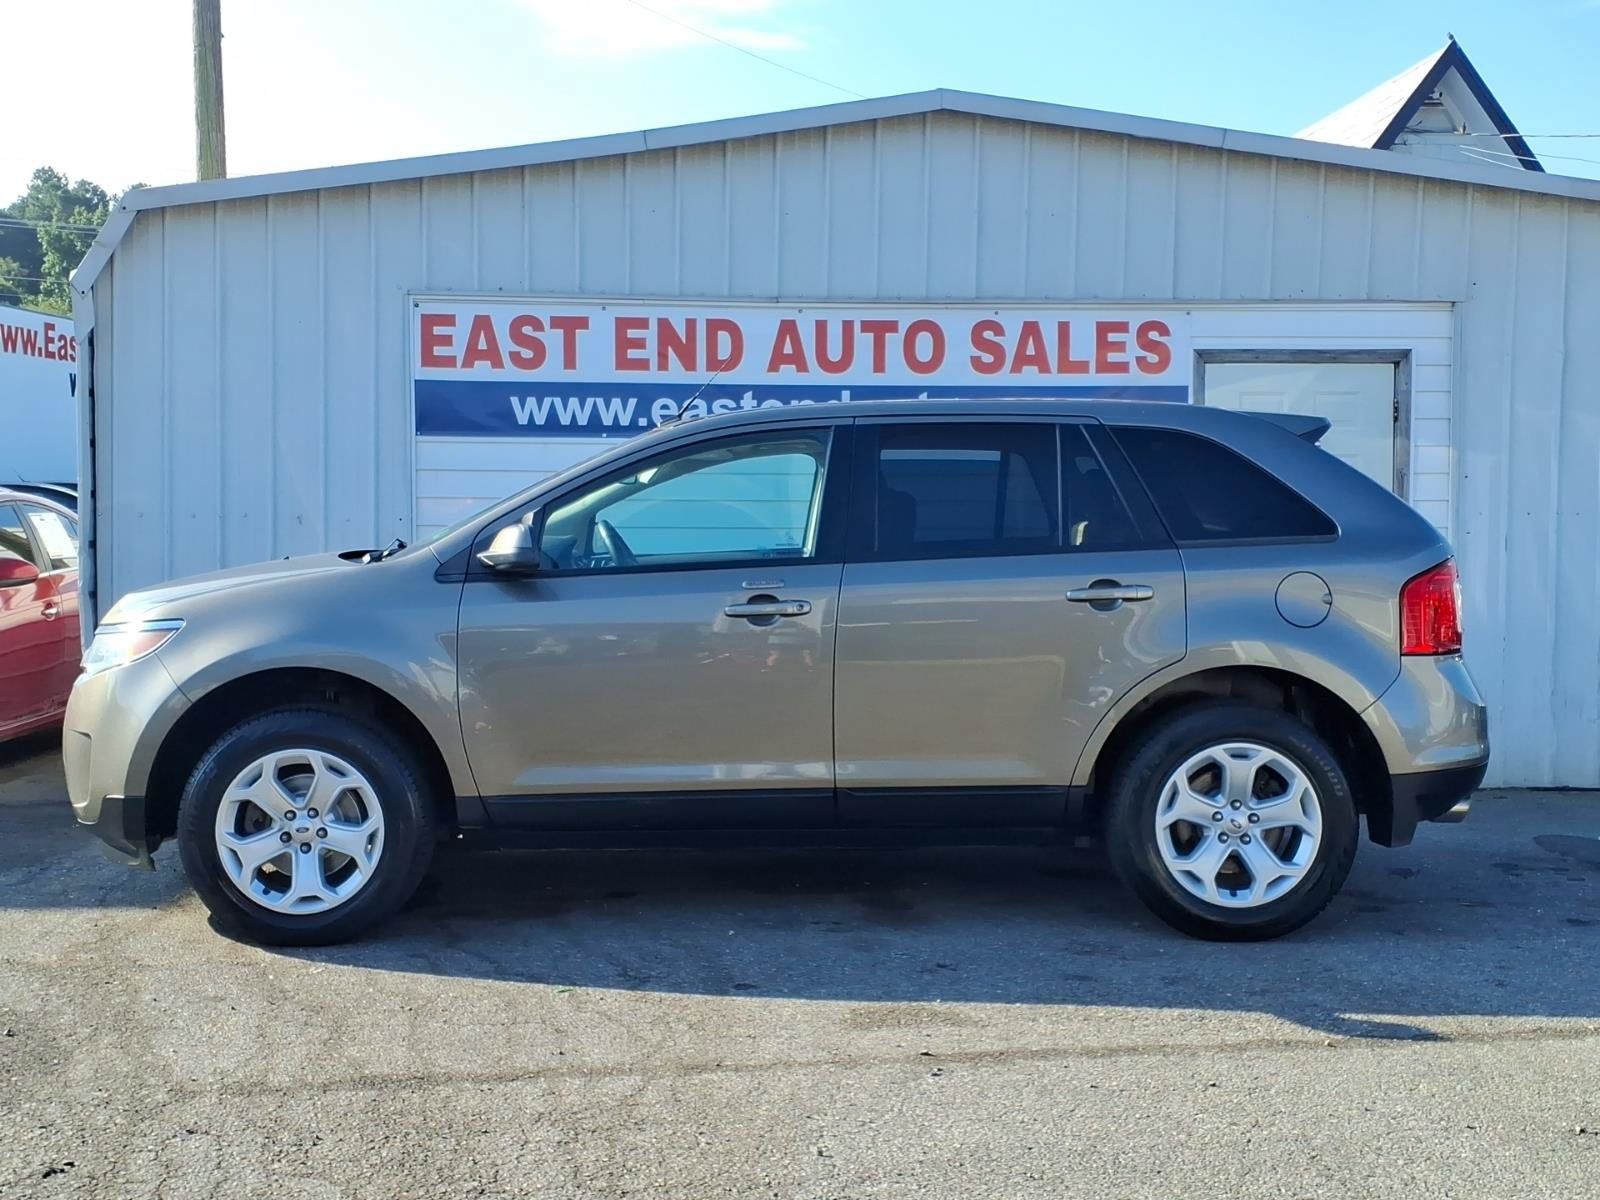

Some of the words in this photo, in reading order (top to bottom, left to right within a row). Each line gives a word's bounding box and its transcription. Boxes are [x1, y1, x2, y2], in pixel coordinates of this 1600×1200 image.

[420, 313, 590, 370] EAST
[614, 316, 744, 373] END
[767, 318, 946, 375] AUTO
[969, 319, 1172, 375] SALES
